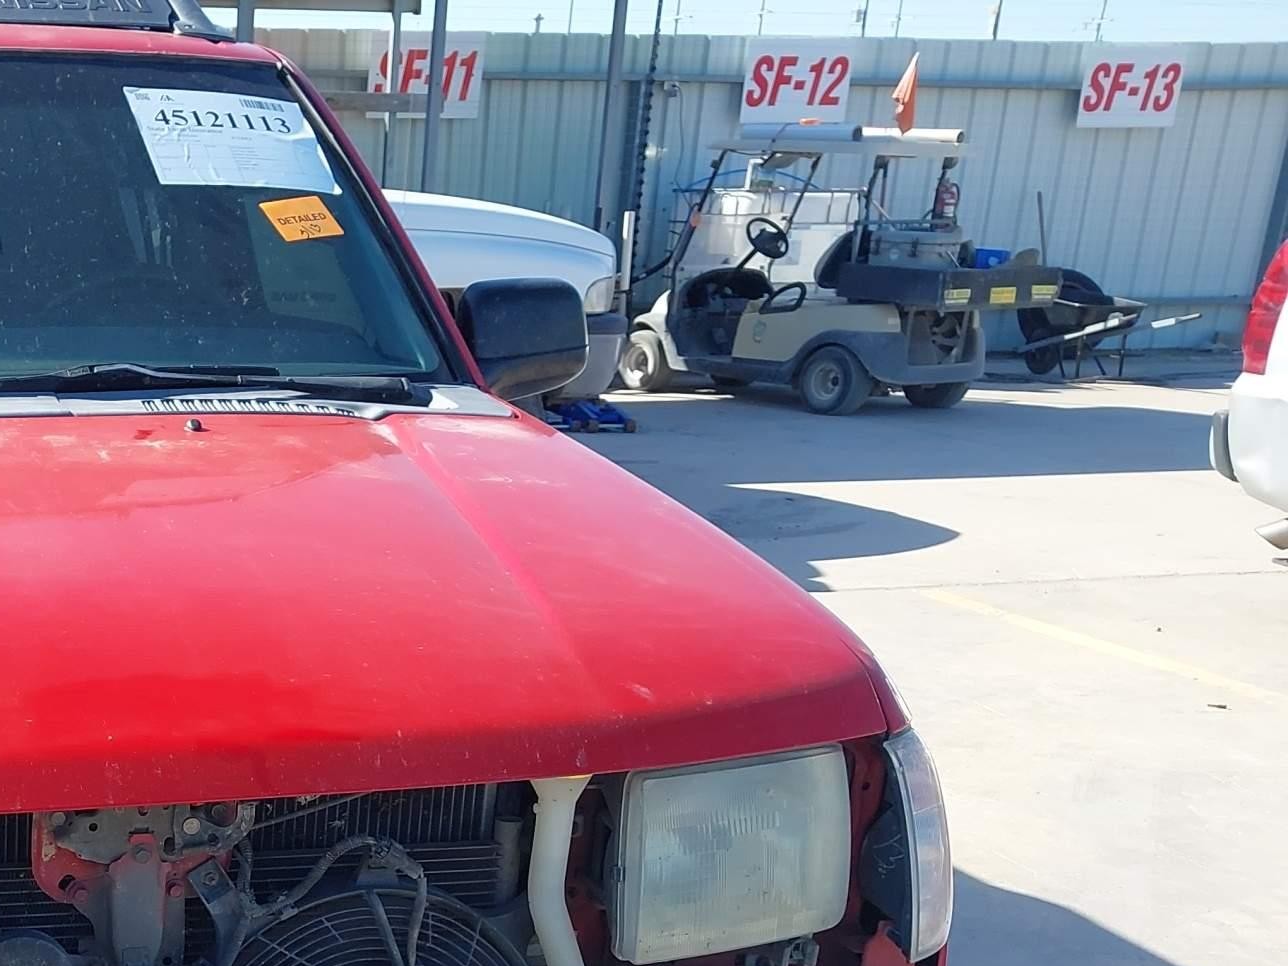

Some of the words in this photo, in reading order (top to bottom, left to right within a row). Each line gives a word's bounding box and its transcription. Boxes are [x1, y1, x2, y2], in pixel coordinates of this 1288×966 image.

[745, 55, 850, 107] SF-12
[1083, 62, 1182, 112] SF-13
[154, 108, 292, 134] 45121113
[277, 212, 328, 226] DETAILED
